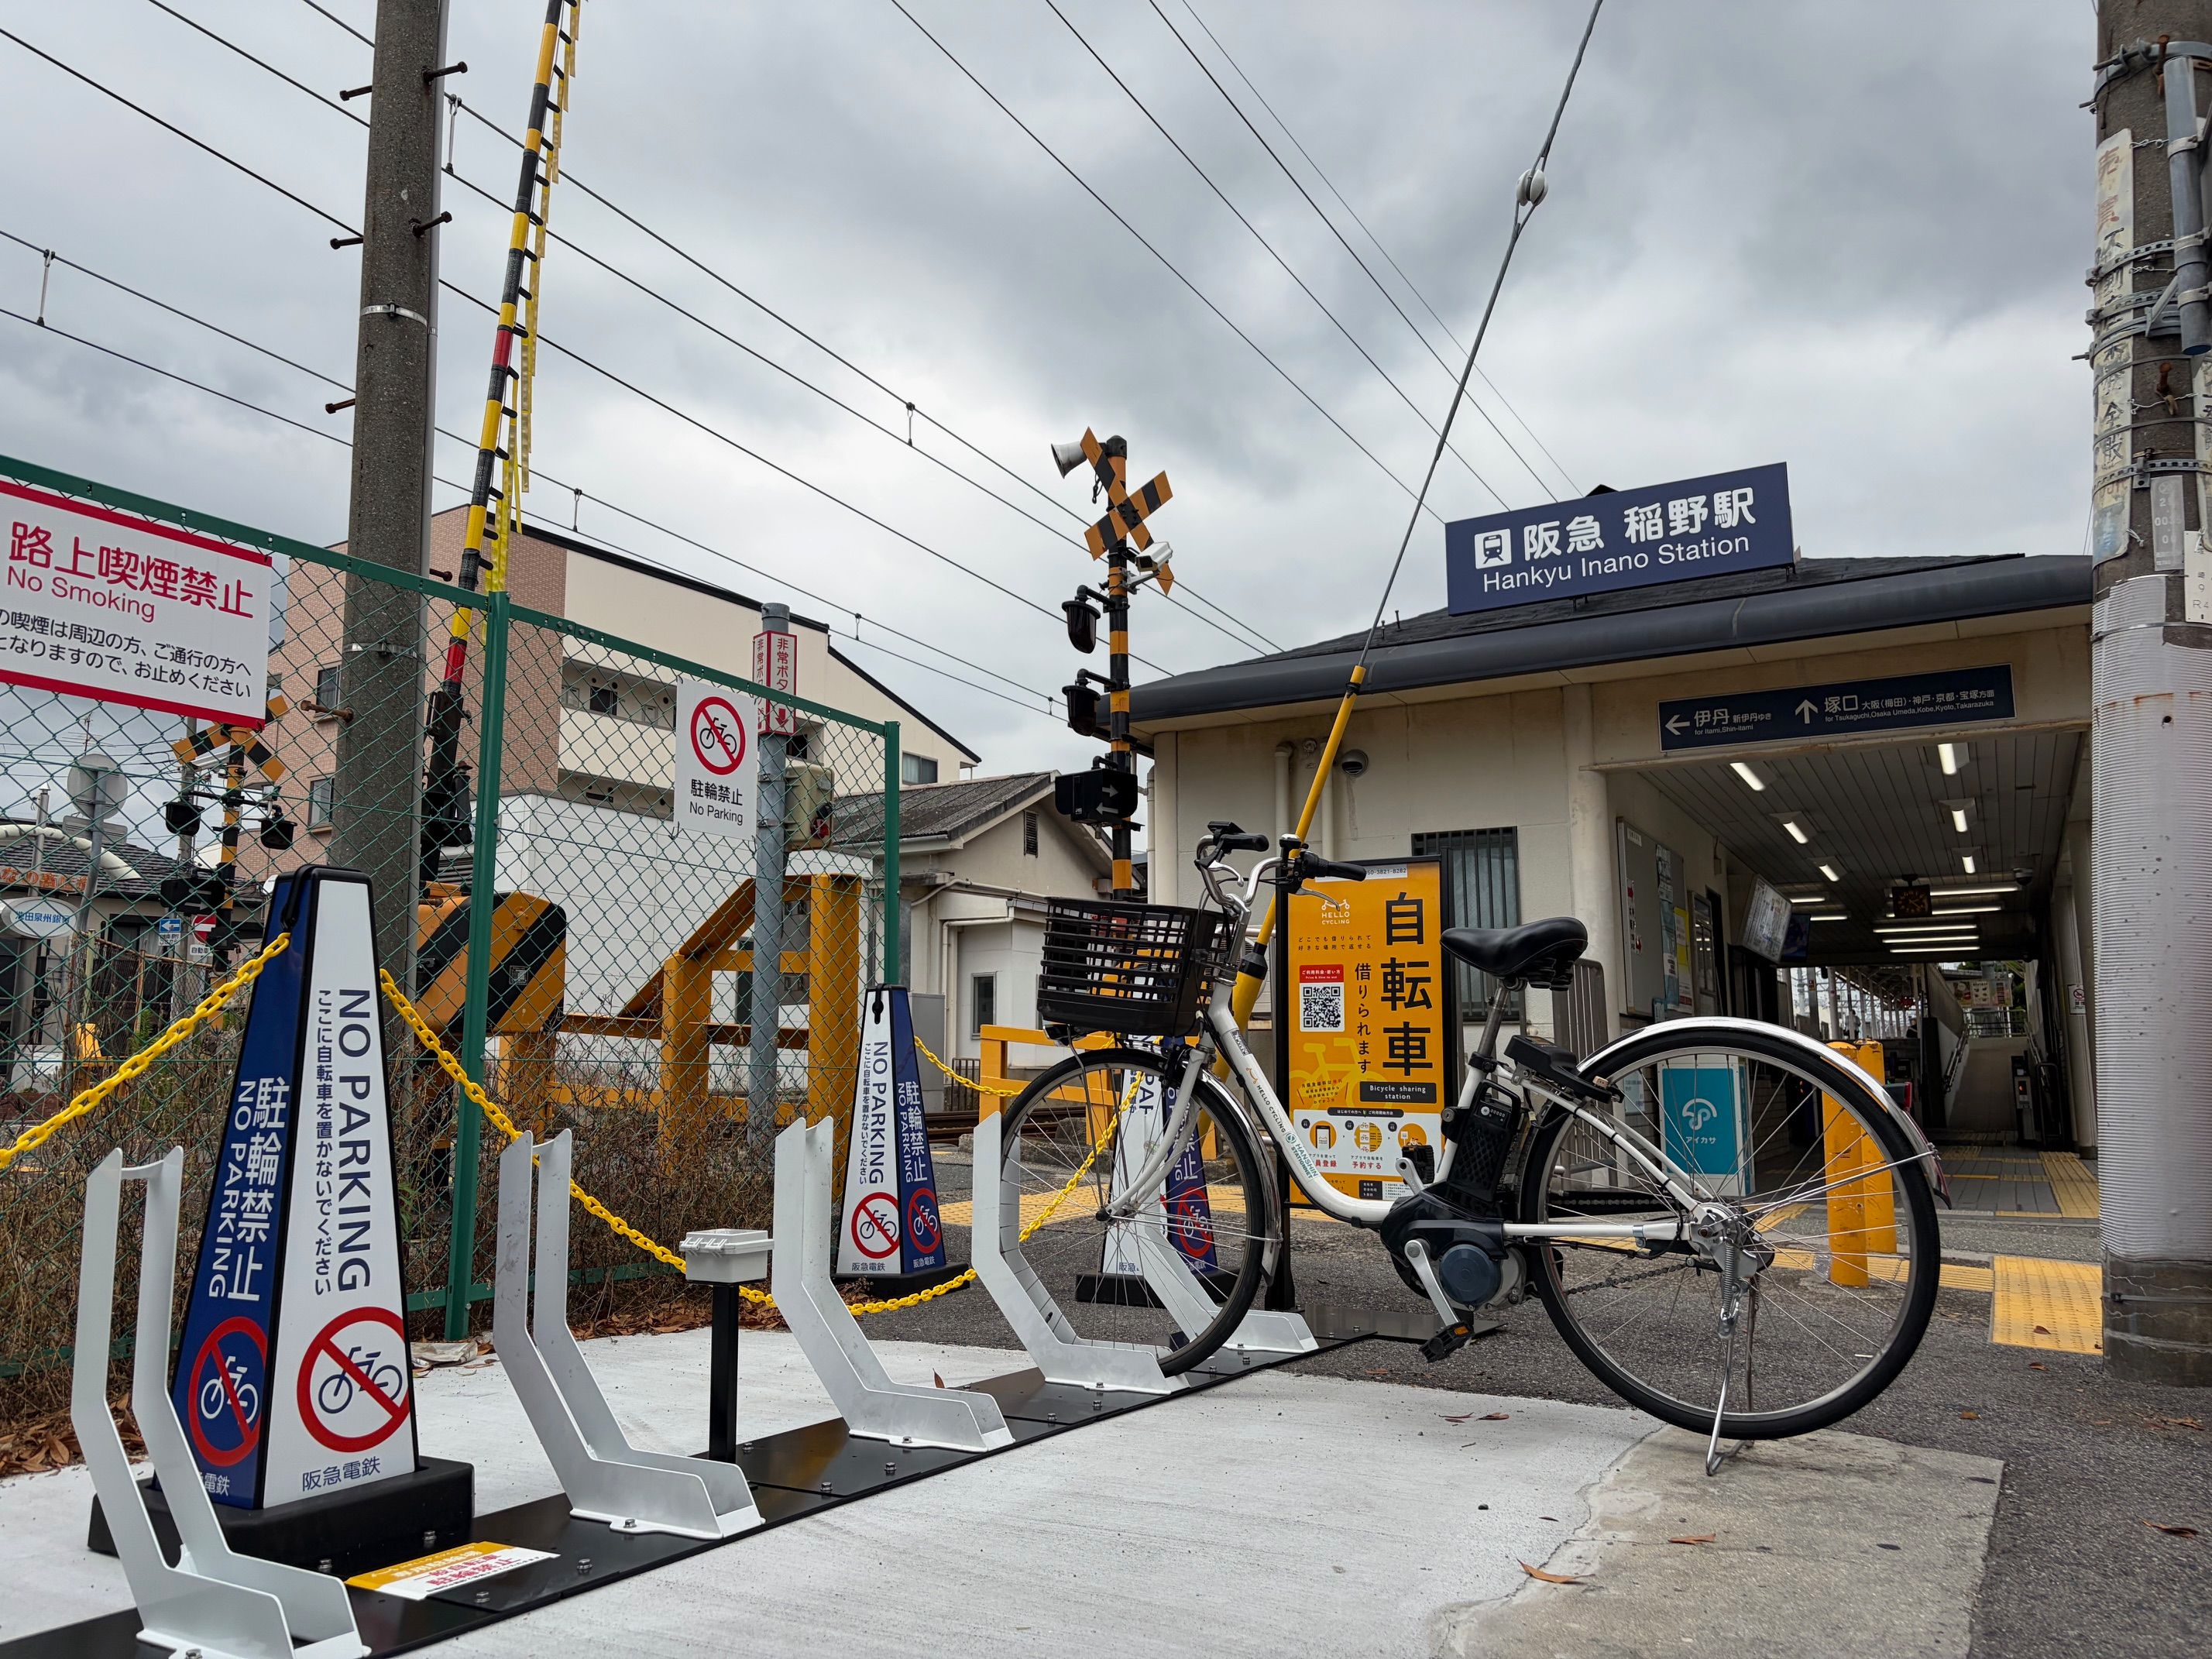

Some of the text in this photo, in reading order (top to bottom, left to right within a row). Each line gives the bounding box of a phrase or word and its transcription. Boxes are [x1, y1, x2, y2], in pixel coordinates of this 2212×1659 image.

[1523, 486, 1757, 562] 阪急 稲野駅
[9, 520, 254, 619] 路上喫煙禁止
[1482, 536, 1750, 593] Hankyu Inano Station
[7, 565, 156, 623] No Smoking
[776, 637, 789, 691] 非常ボタ
[1693, 708, 1772, 728] 伊丹 新伊丹ゆき
[1823, 695, 1859, 713] 塚口
[1835, 707, 1891, 722] Tsukaguchi,Osaka
[689, 801, 744, 826] No Parking
[690, 778, 744, 807] 駐輪禁止
[1380, 891, 1433, 1077] 自転車
[1355, 962, 1372, 1073] 借りられます
[859, 1042, 871, 1185] ここに自転車を置かないでください
[868, 1041, 889, 1185] NO PARKING
[897, 1082, 914, 1184] NO PARKING
[905, 1081, 928, 1182] 駐輪禁止
[1256, 1084, 1286, 1133] HELLO CYCLING
[314, 989, 334, 1297] ここに自転車を置かないでください
[338, 989, 372, 1292] NO PARKING
[1295, 1143, 1319, 1177] HANSHIN
[1314, 1159, 1337, 1167] 員登録
[1352, 1161, 1382, 1170] 予約する
[208, 1080, 256, 1299] NO PARKING
[227, 1076, 291, 1302] 駐輪禁止
[852, 1262, 886, 1272] 阪急電鉄
[912, 1256, 936, 1269] 阪急電鉄
[198, 1472, 231, 1497] 電鉄
[302, 1456, 381, 1492] 阪急電鉄
[426, 1558, 521, 1586] 駐輪禁止
